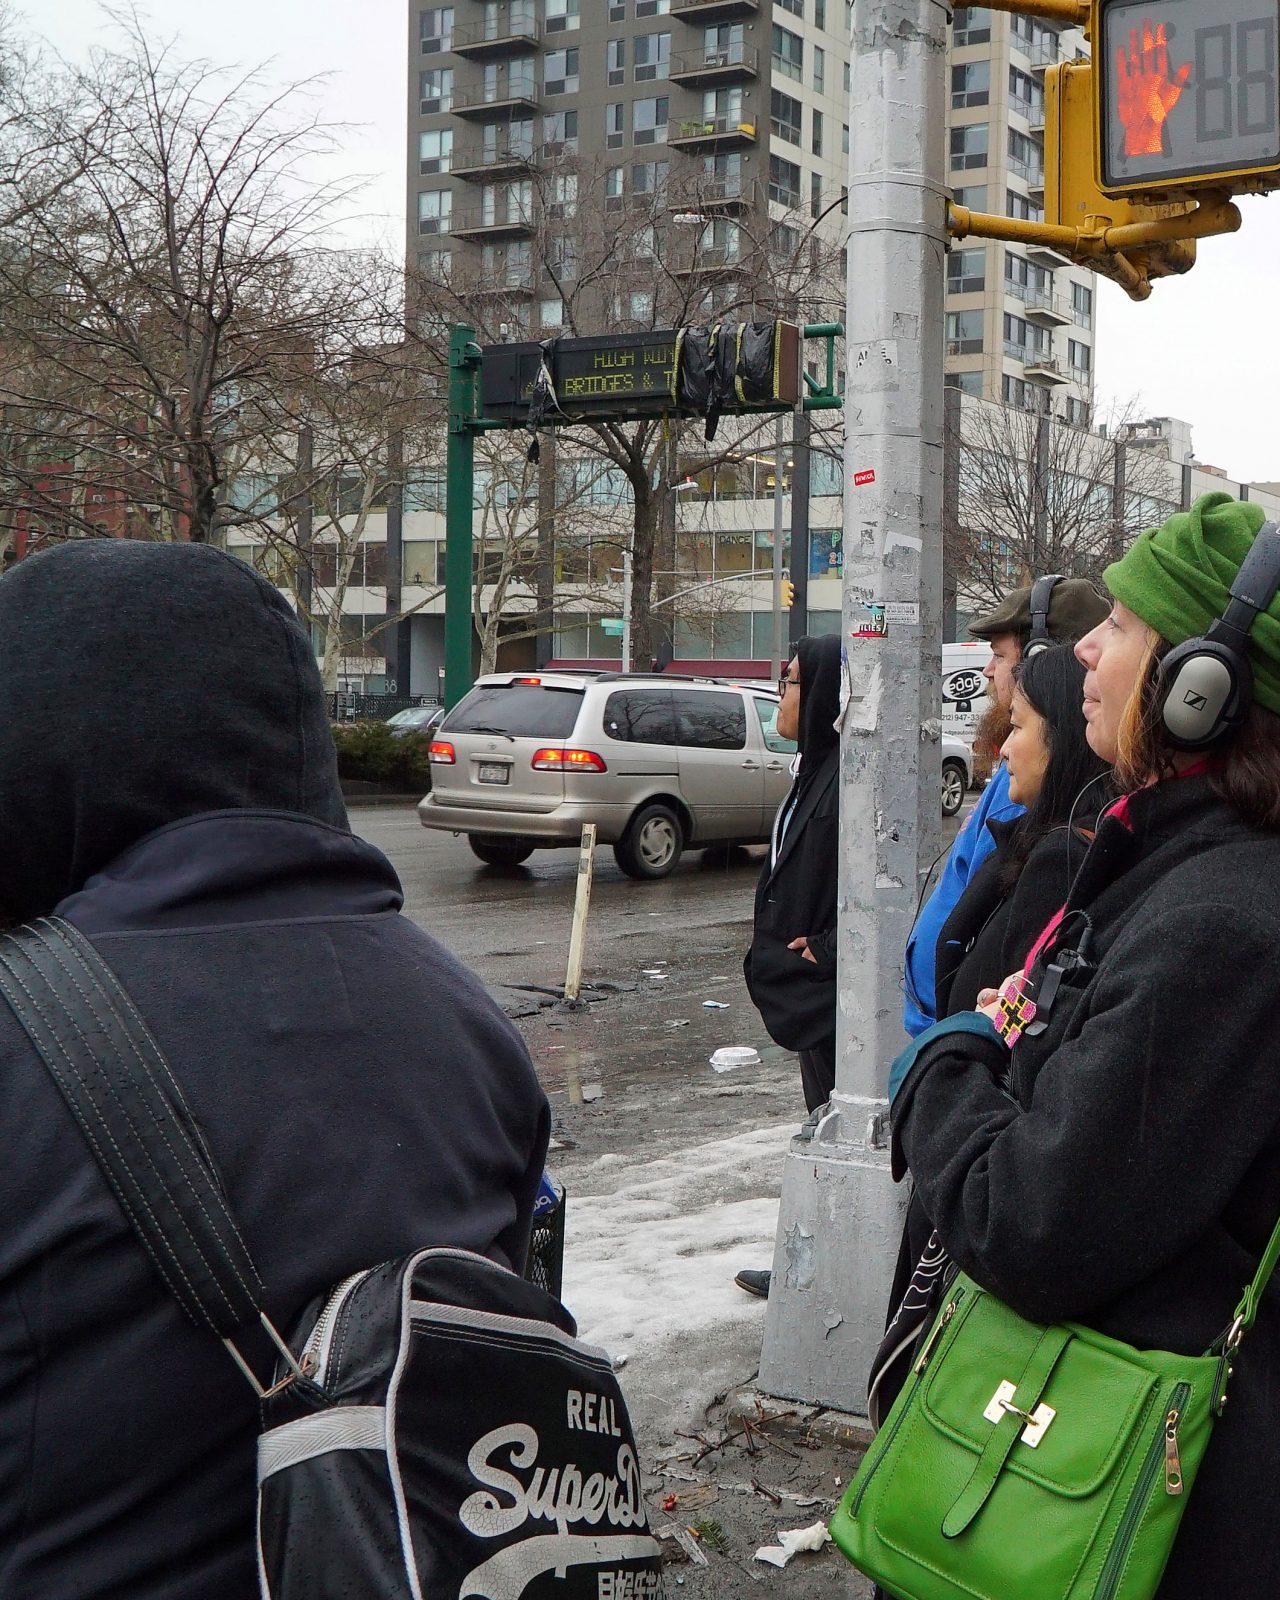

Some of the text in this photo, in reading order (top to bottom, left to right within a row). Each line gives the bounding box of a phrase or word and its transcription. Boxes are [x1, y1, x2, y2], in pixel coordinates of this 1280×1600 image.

[593, 350, 635, 369] HIGH
[565, 374, 634, 396] BRIDGES
[719, 535, 752, 545] DANCE
[949, 675, 981, 694] edge
[567, 1389, 622, 1438] REAL
